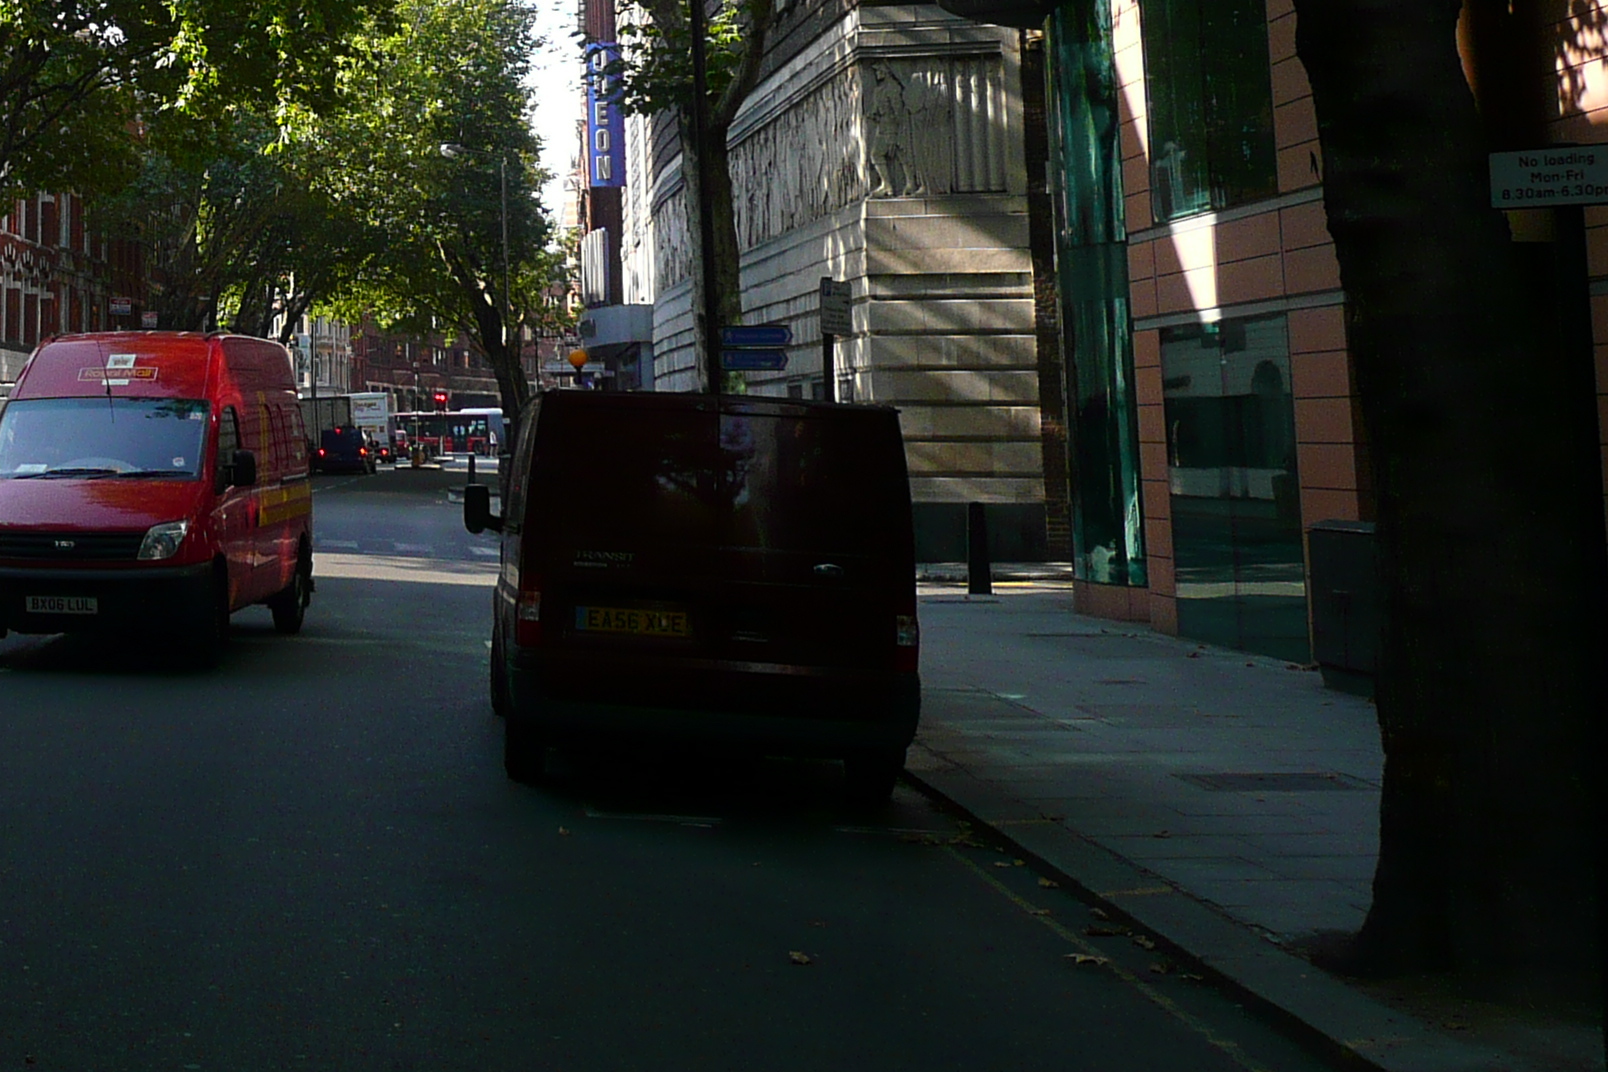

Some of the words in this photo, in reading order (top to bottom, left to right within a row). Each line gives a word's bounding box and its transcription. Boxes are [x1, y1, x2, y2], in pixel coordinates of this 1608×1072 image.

[1519, 156, 1538, 168] No
[1544, 153, 1595, 166] loading
[1530, 170, 1584, 184] Mon-Fri
[123, 368, 152, 377] Mail
[576, 549, 636, 562] TRANSIT
[32, 597, 64, 611] BX06
[68, 598, 93, 611] LUL
[588, 609, 639, 629] EA56
